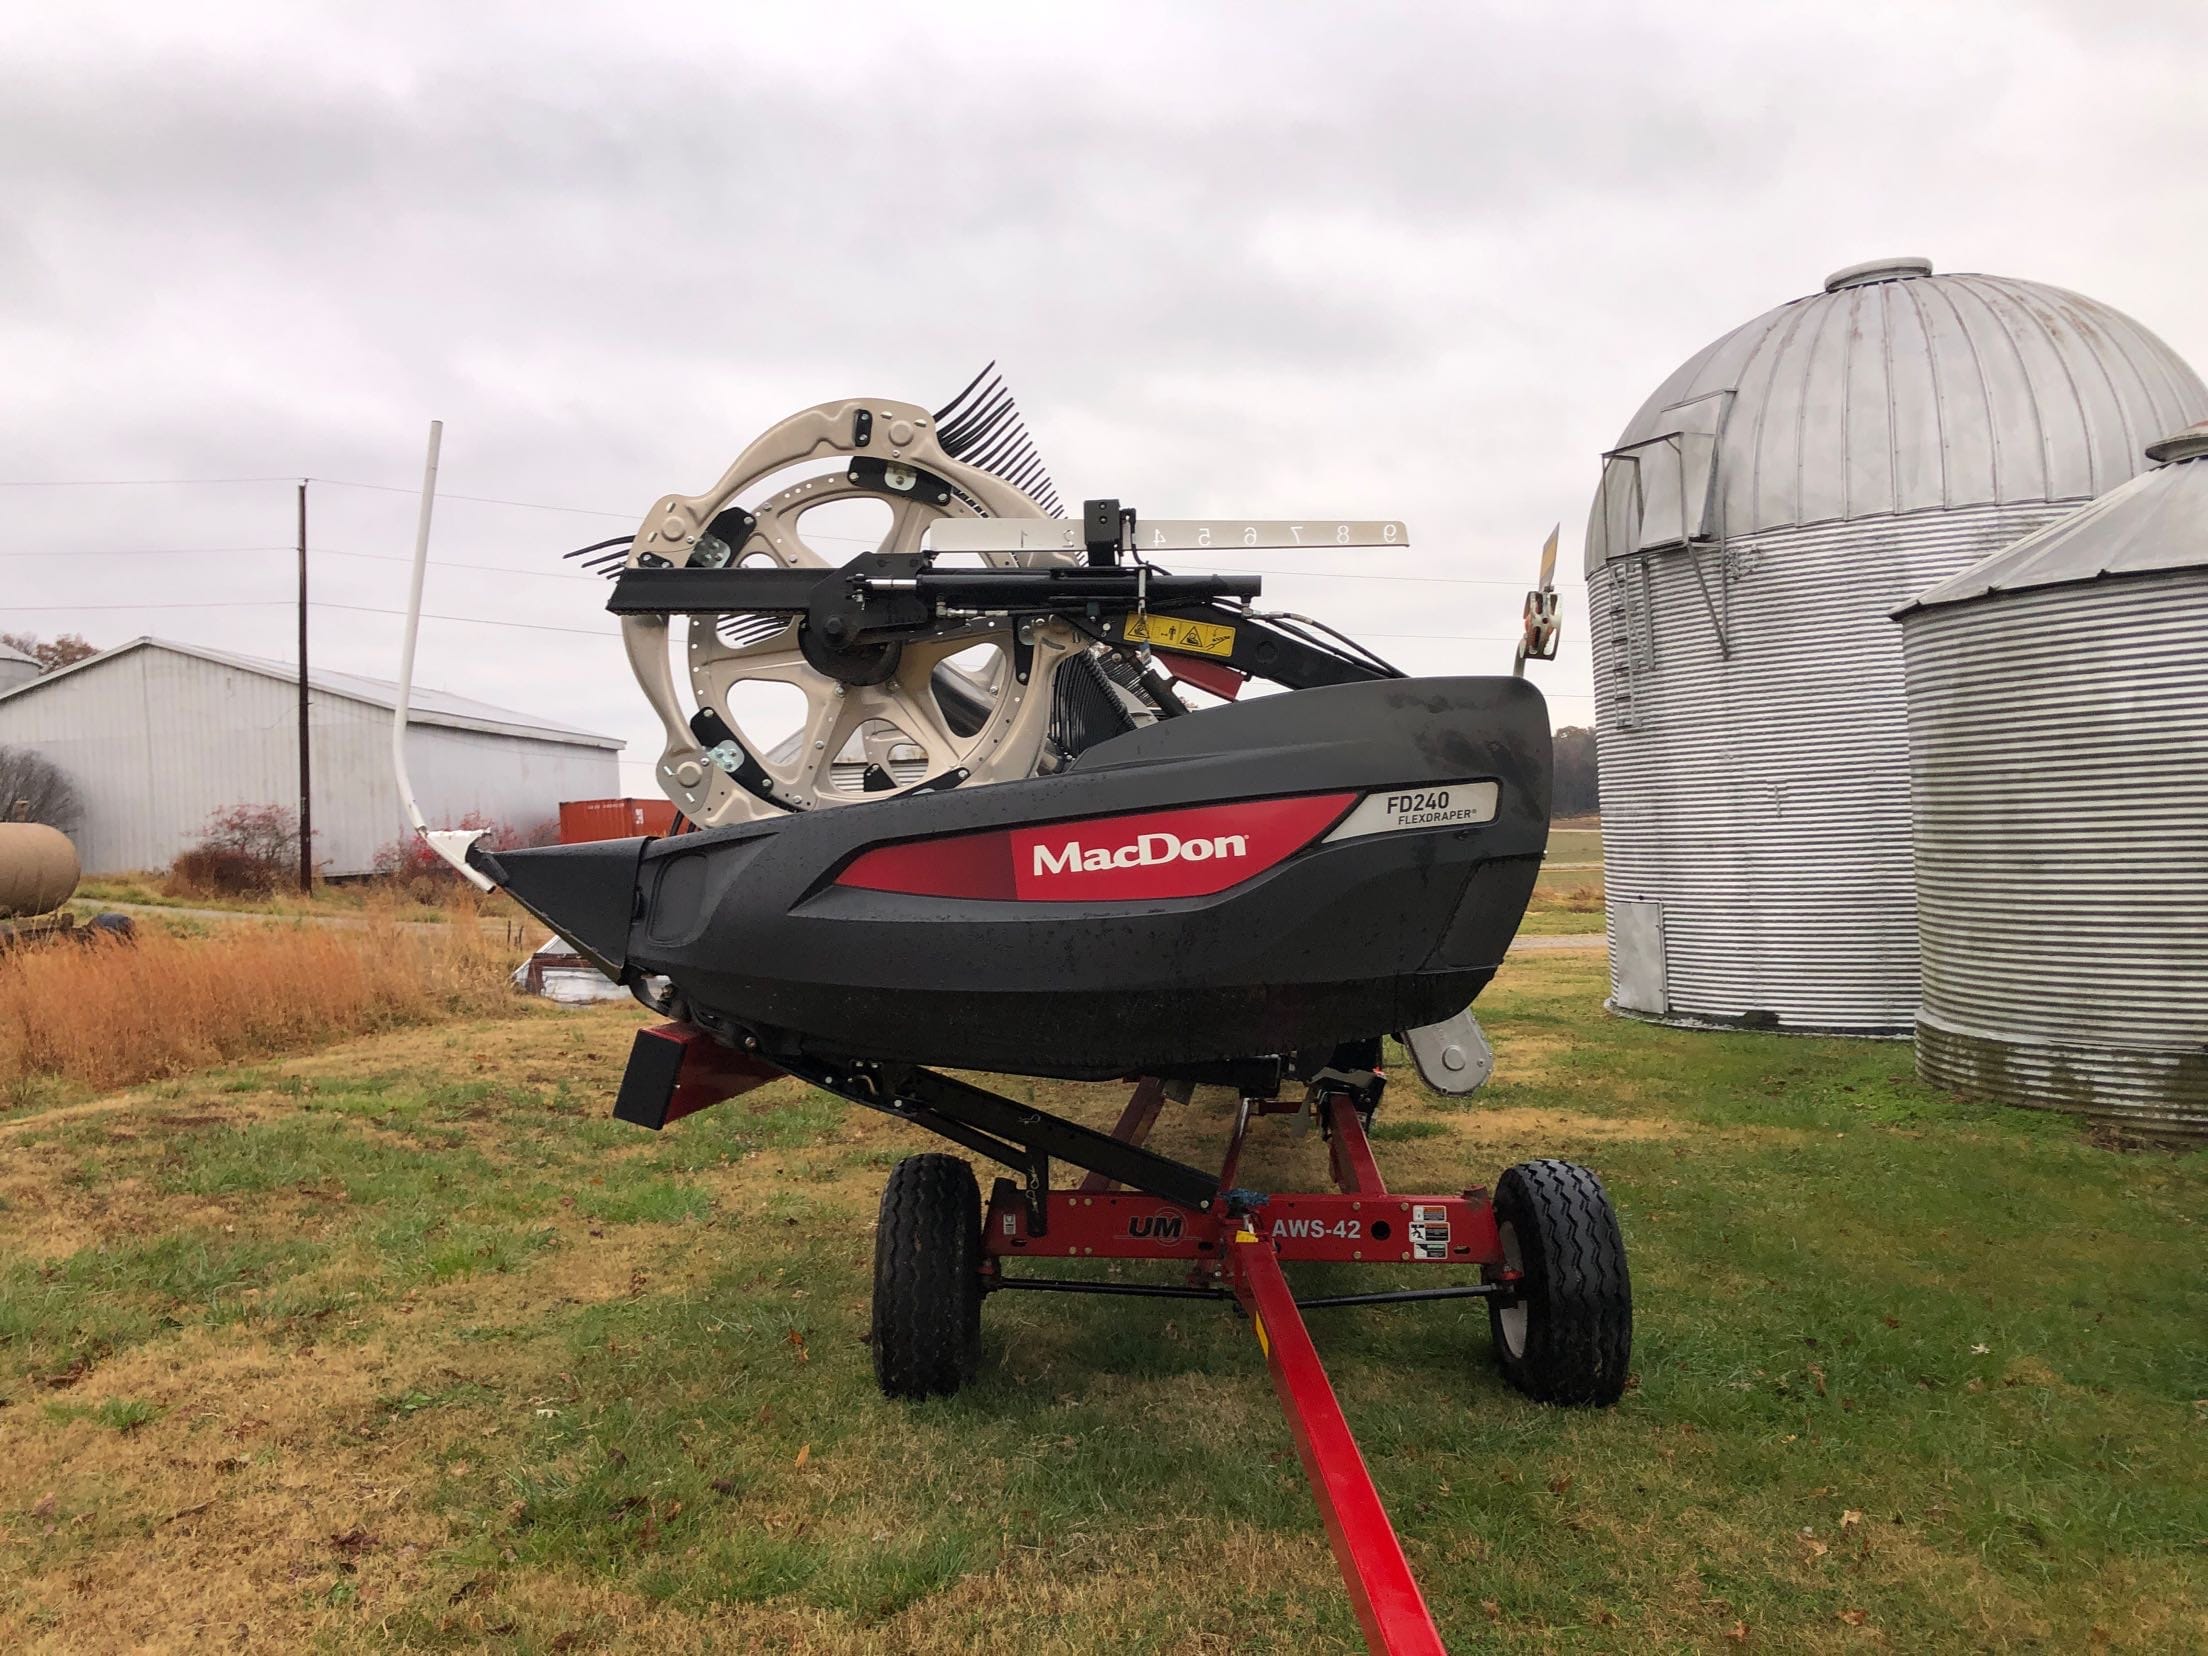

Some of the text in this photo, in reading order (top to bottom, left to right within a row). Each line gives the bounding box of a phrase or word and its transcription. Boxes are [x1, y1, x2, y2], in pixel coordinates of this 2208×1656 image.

[1387, 791, 1450, 814] FD240
[1033, 833, 1247, 876] MacDon
[1128, 1216, 1182, 1238] UM
[1271, 1219, 1362, 1239] AWS-42
